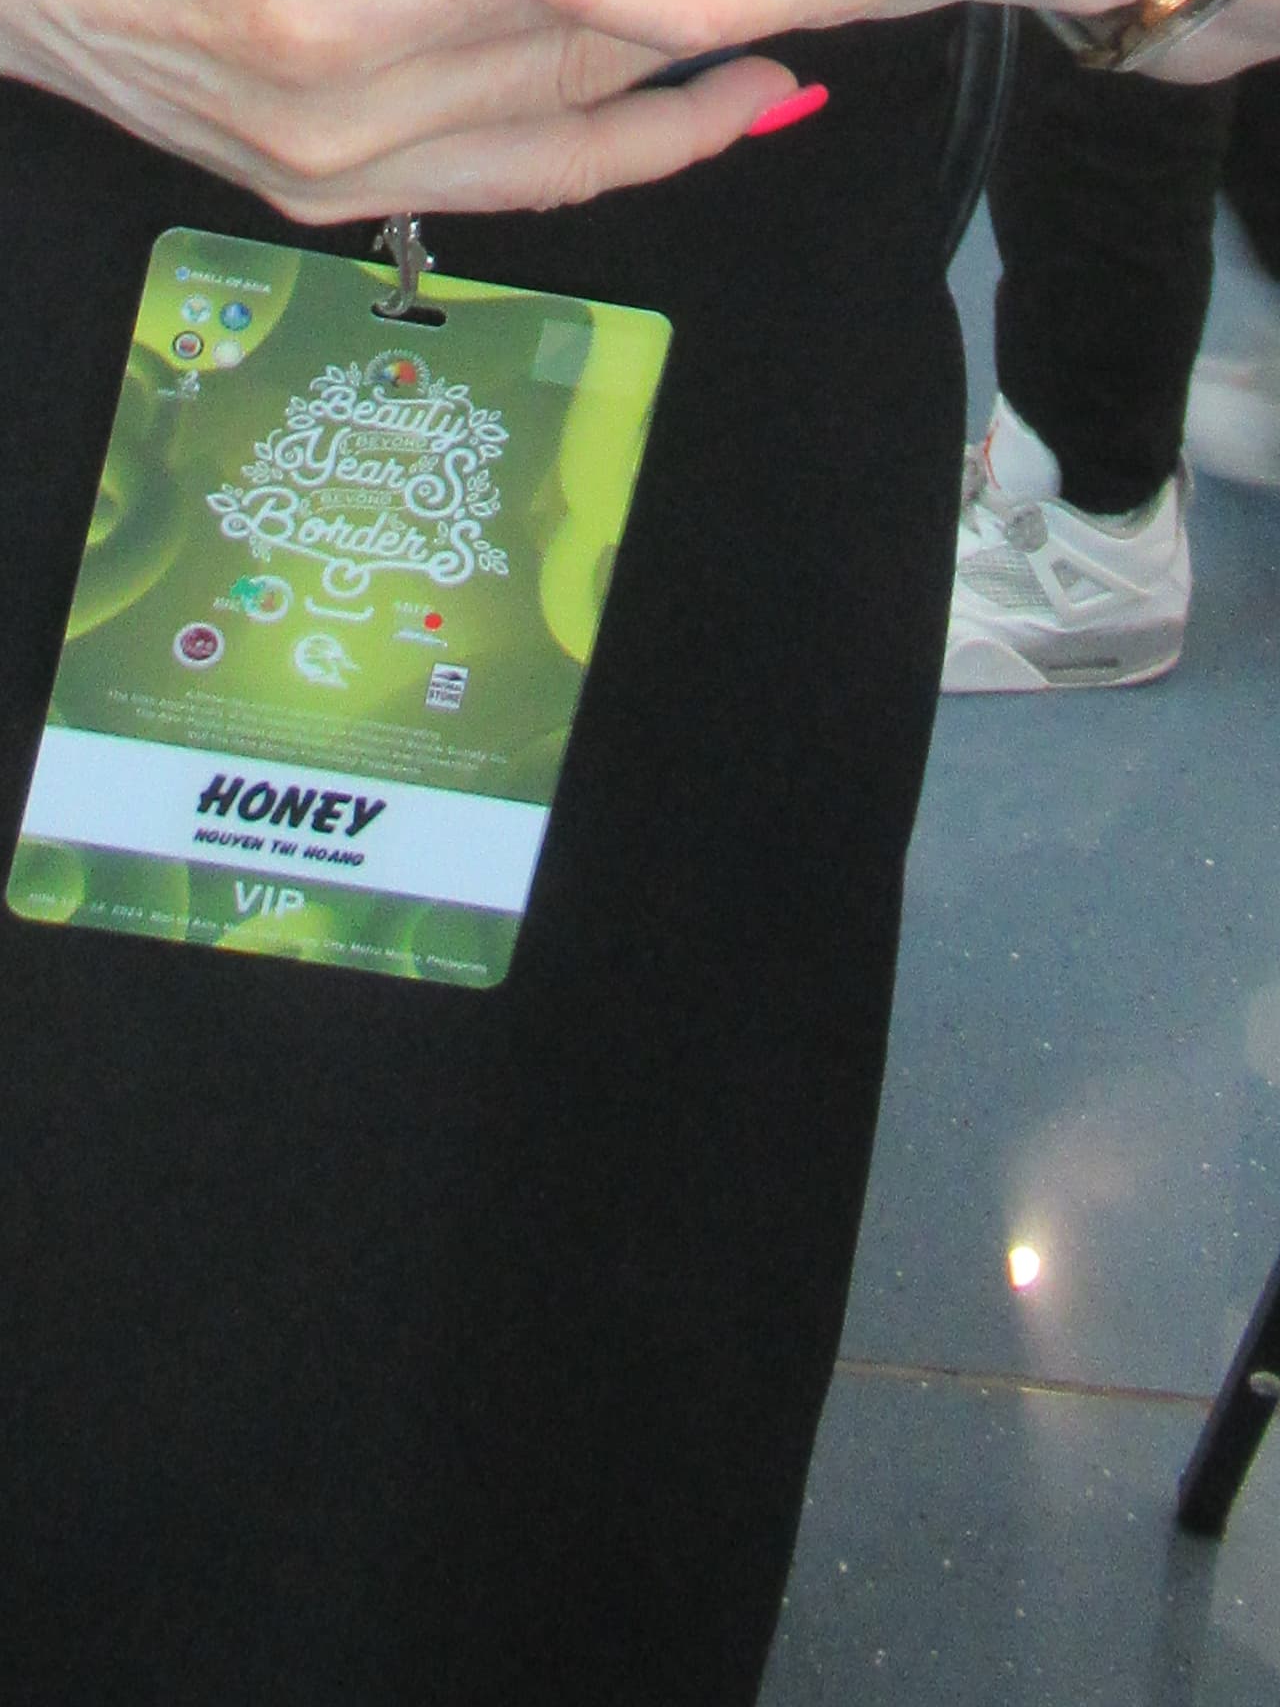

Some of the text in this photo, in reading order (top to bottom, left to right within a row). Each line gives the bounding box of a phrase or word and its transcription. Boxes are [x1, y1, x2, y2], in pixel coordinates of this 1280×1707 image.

[308, 385, 472, 454] Beauty
[197, 773, 387, 837] HONEY
[234, 880, 305, 919] VIP
